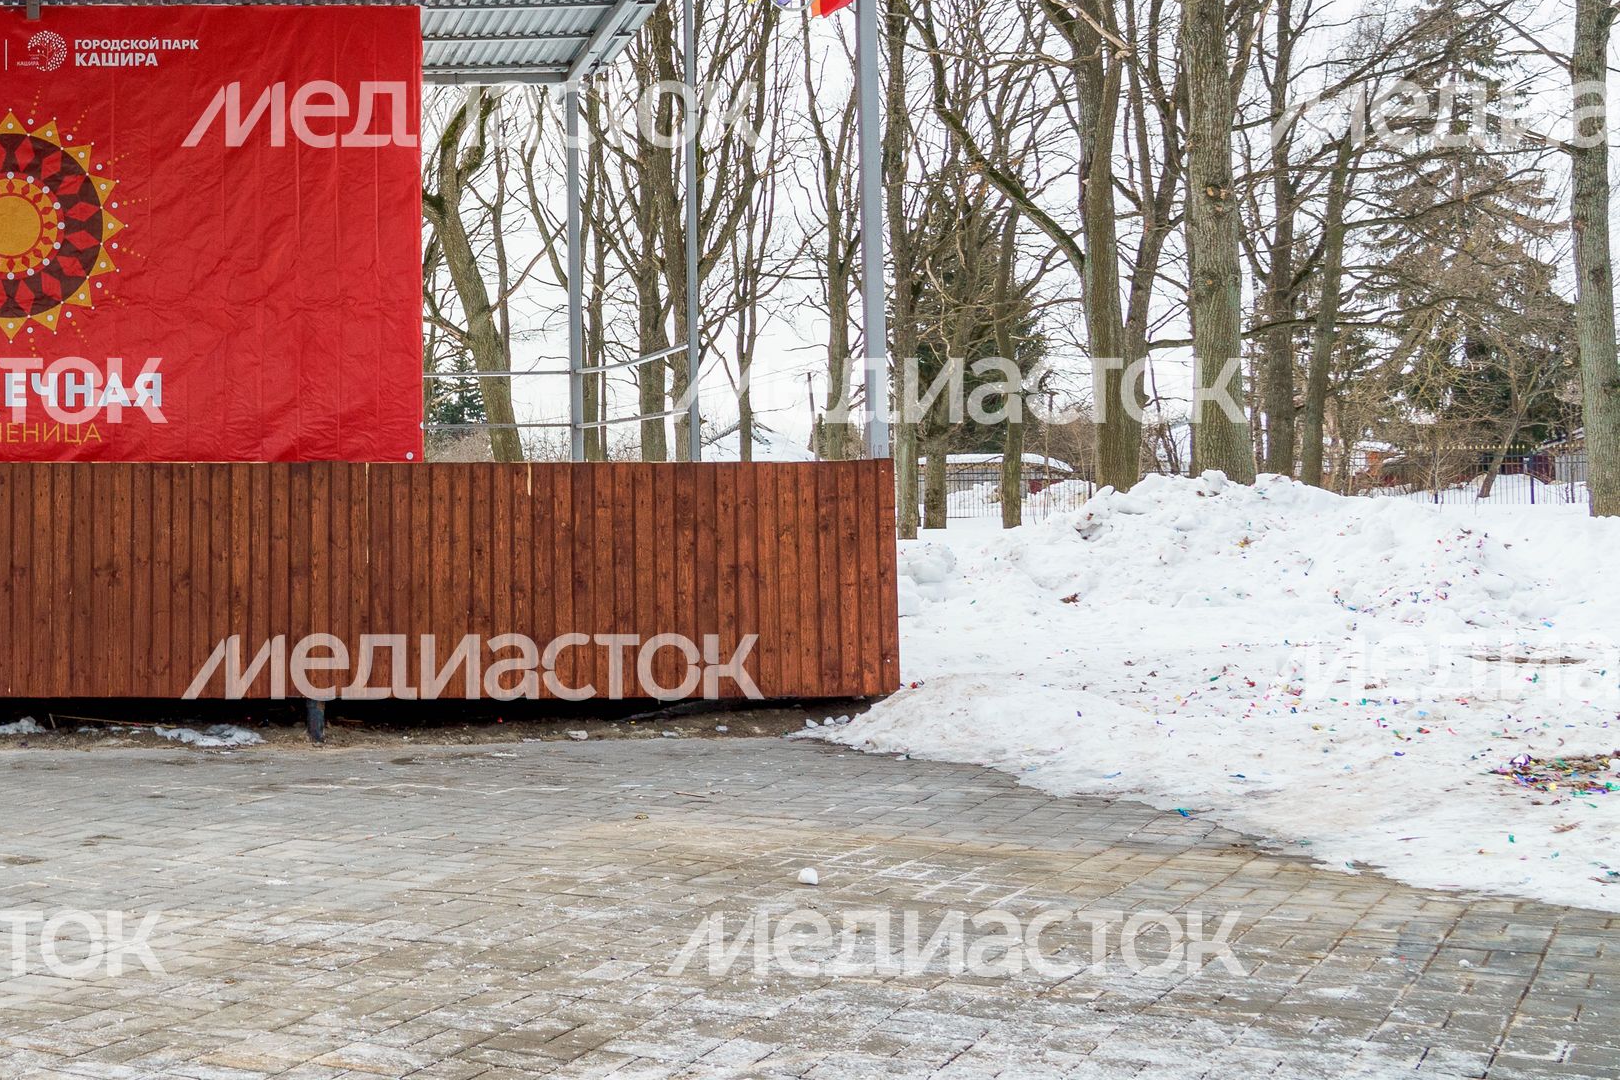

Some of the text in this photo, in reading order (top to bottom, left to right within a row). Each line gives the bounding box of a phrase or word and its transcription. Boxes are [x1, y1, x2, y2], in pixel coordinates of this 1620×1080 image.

[74, 37, 199, 51] ГОРОДСКОЙ ПАРК
[75, 52, 159, 67] КАШИРА
